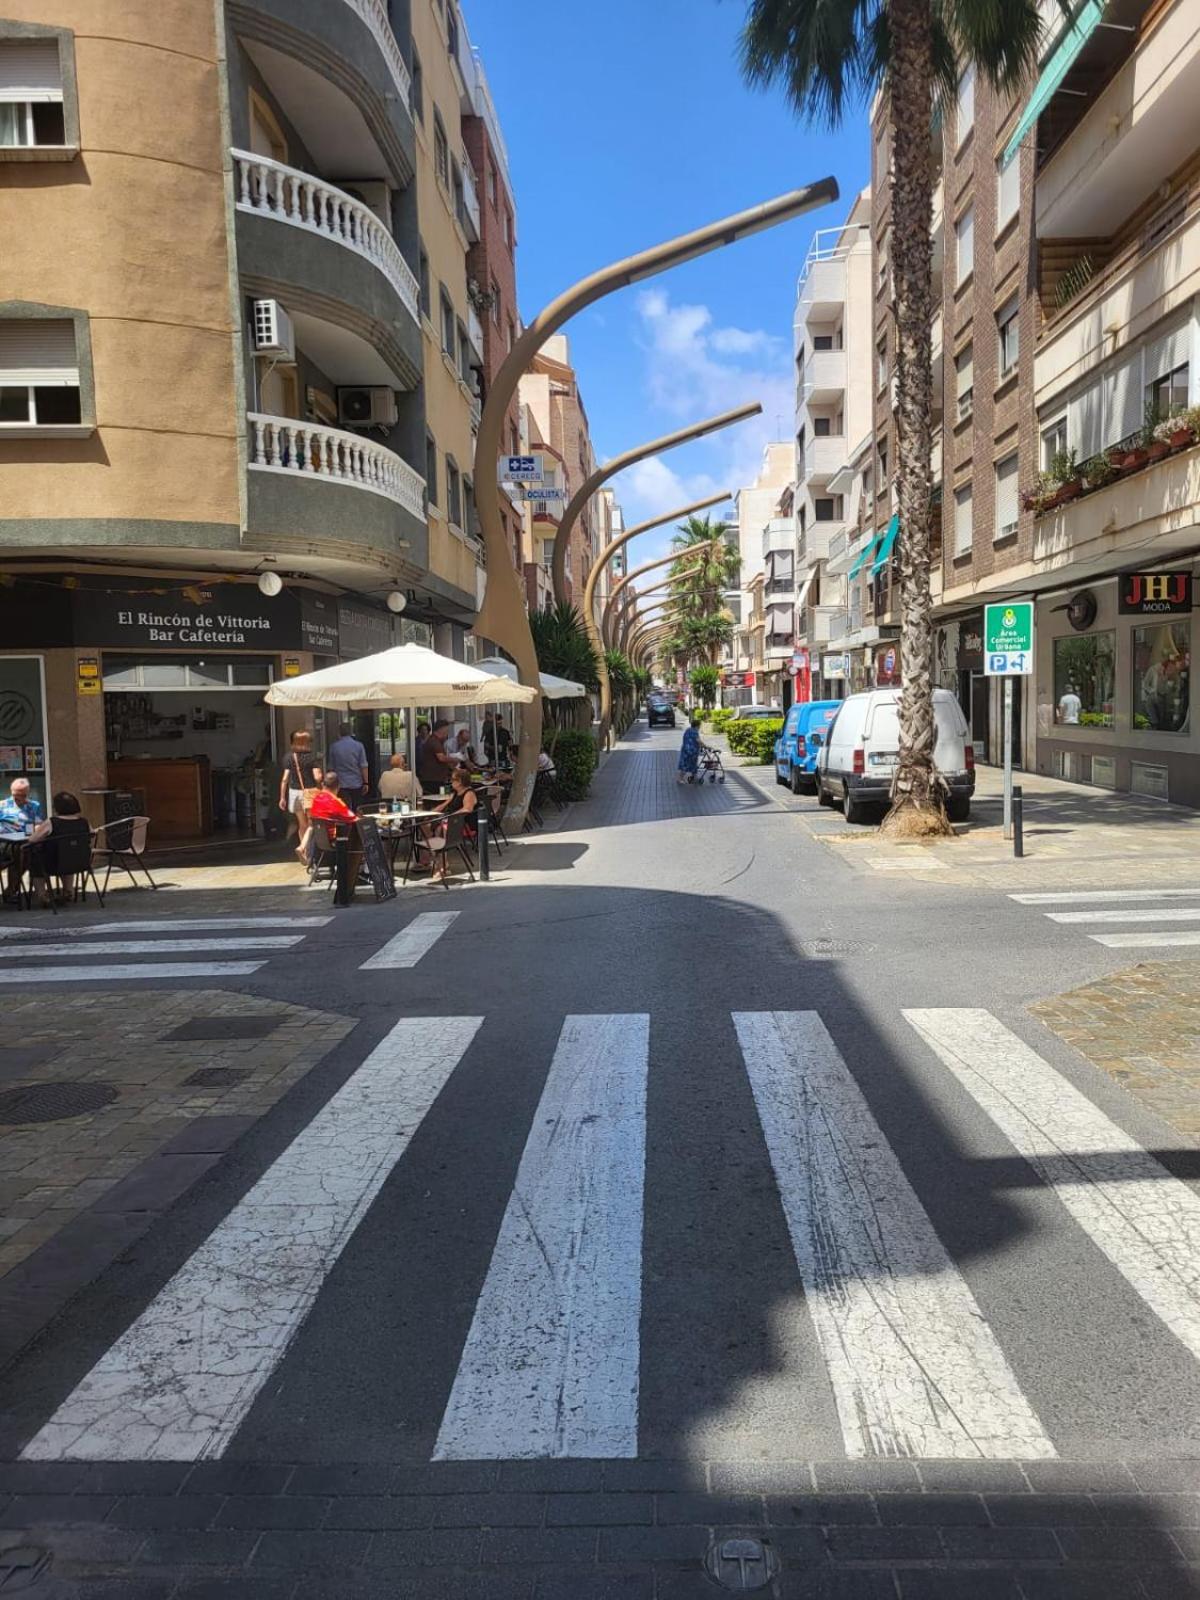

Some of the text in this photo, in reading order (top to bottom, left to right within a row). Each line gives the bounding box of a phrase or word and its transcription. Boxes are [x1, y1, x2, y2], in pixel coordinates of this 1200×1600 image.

[527, 490, 559, 499] OCULISTA
[1126, 575, 1188, 604] JHJ
[1143, 603, 1172, 612] MODA
[118, 611, 271, 630] El Rincón de Vittoria
[149, 629, 246, 643] Bar Cafetería
[991, 635, 1026, 644] Comercial
